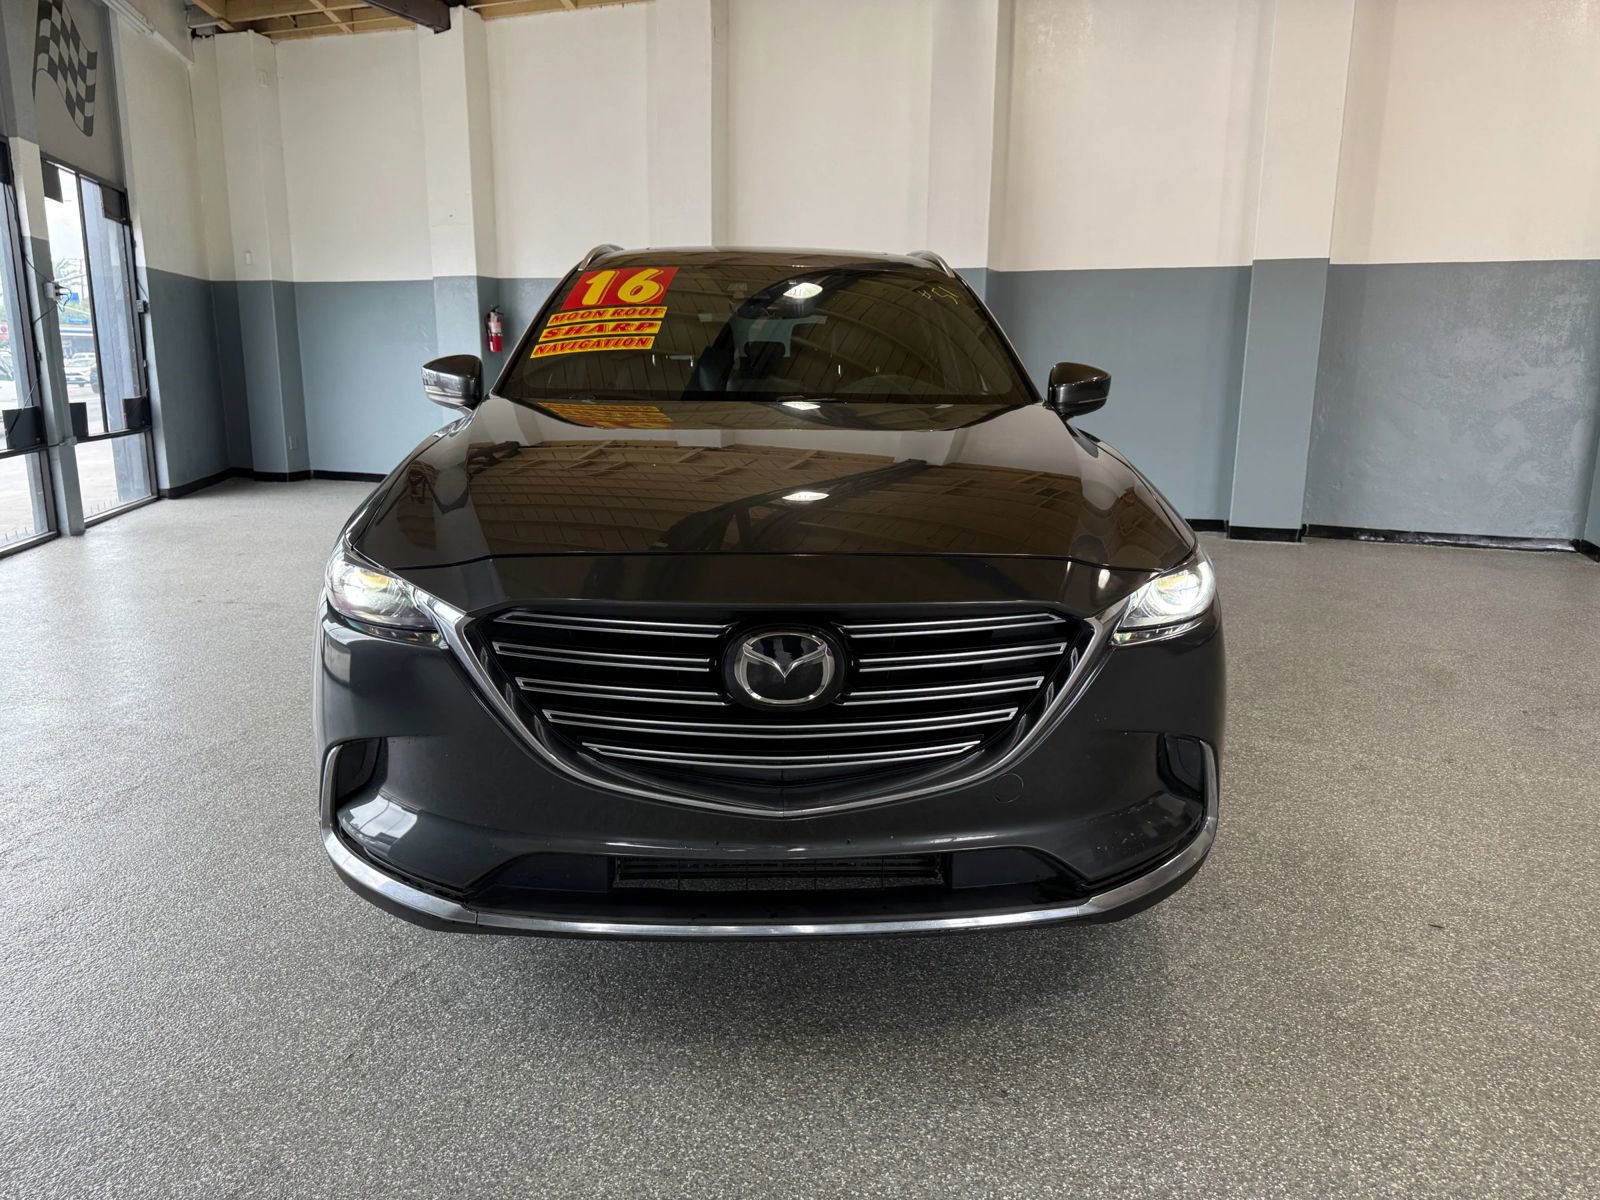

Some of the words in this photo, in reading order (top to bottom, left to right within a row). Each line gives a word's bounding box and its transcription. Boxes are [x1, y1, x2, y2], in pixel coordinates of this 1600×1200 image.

[582, 268, 664, 305] 16
[549, 311, 605, 324] MOON
[610, 307, 661, 318] ROOF
[543, 322, 656, 338] SHARP
[533, 337, 650, 356] NAVIGATION
